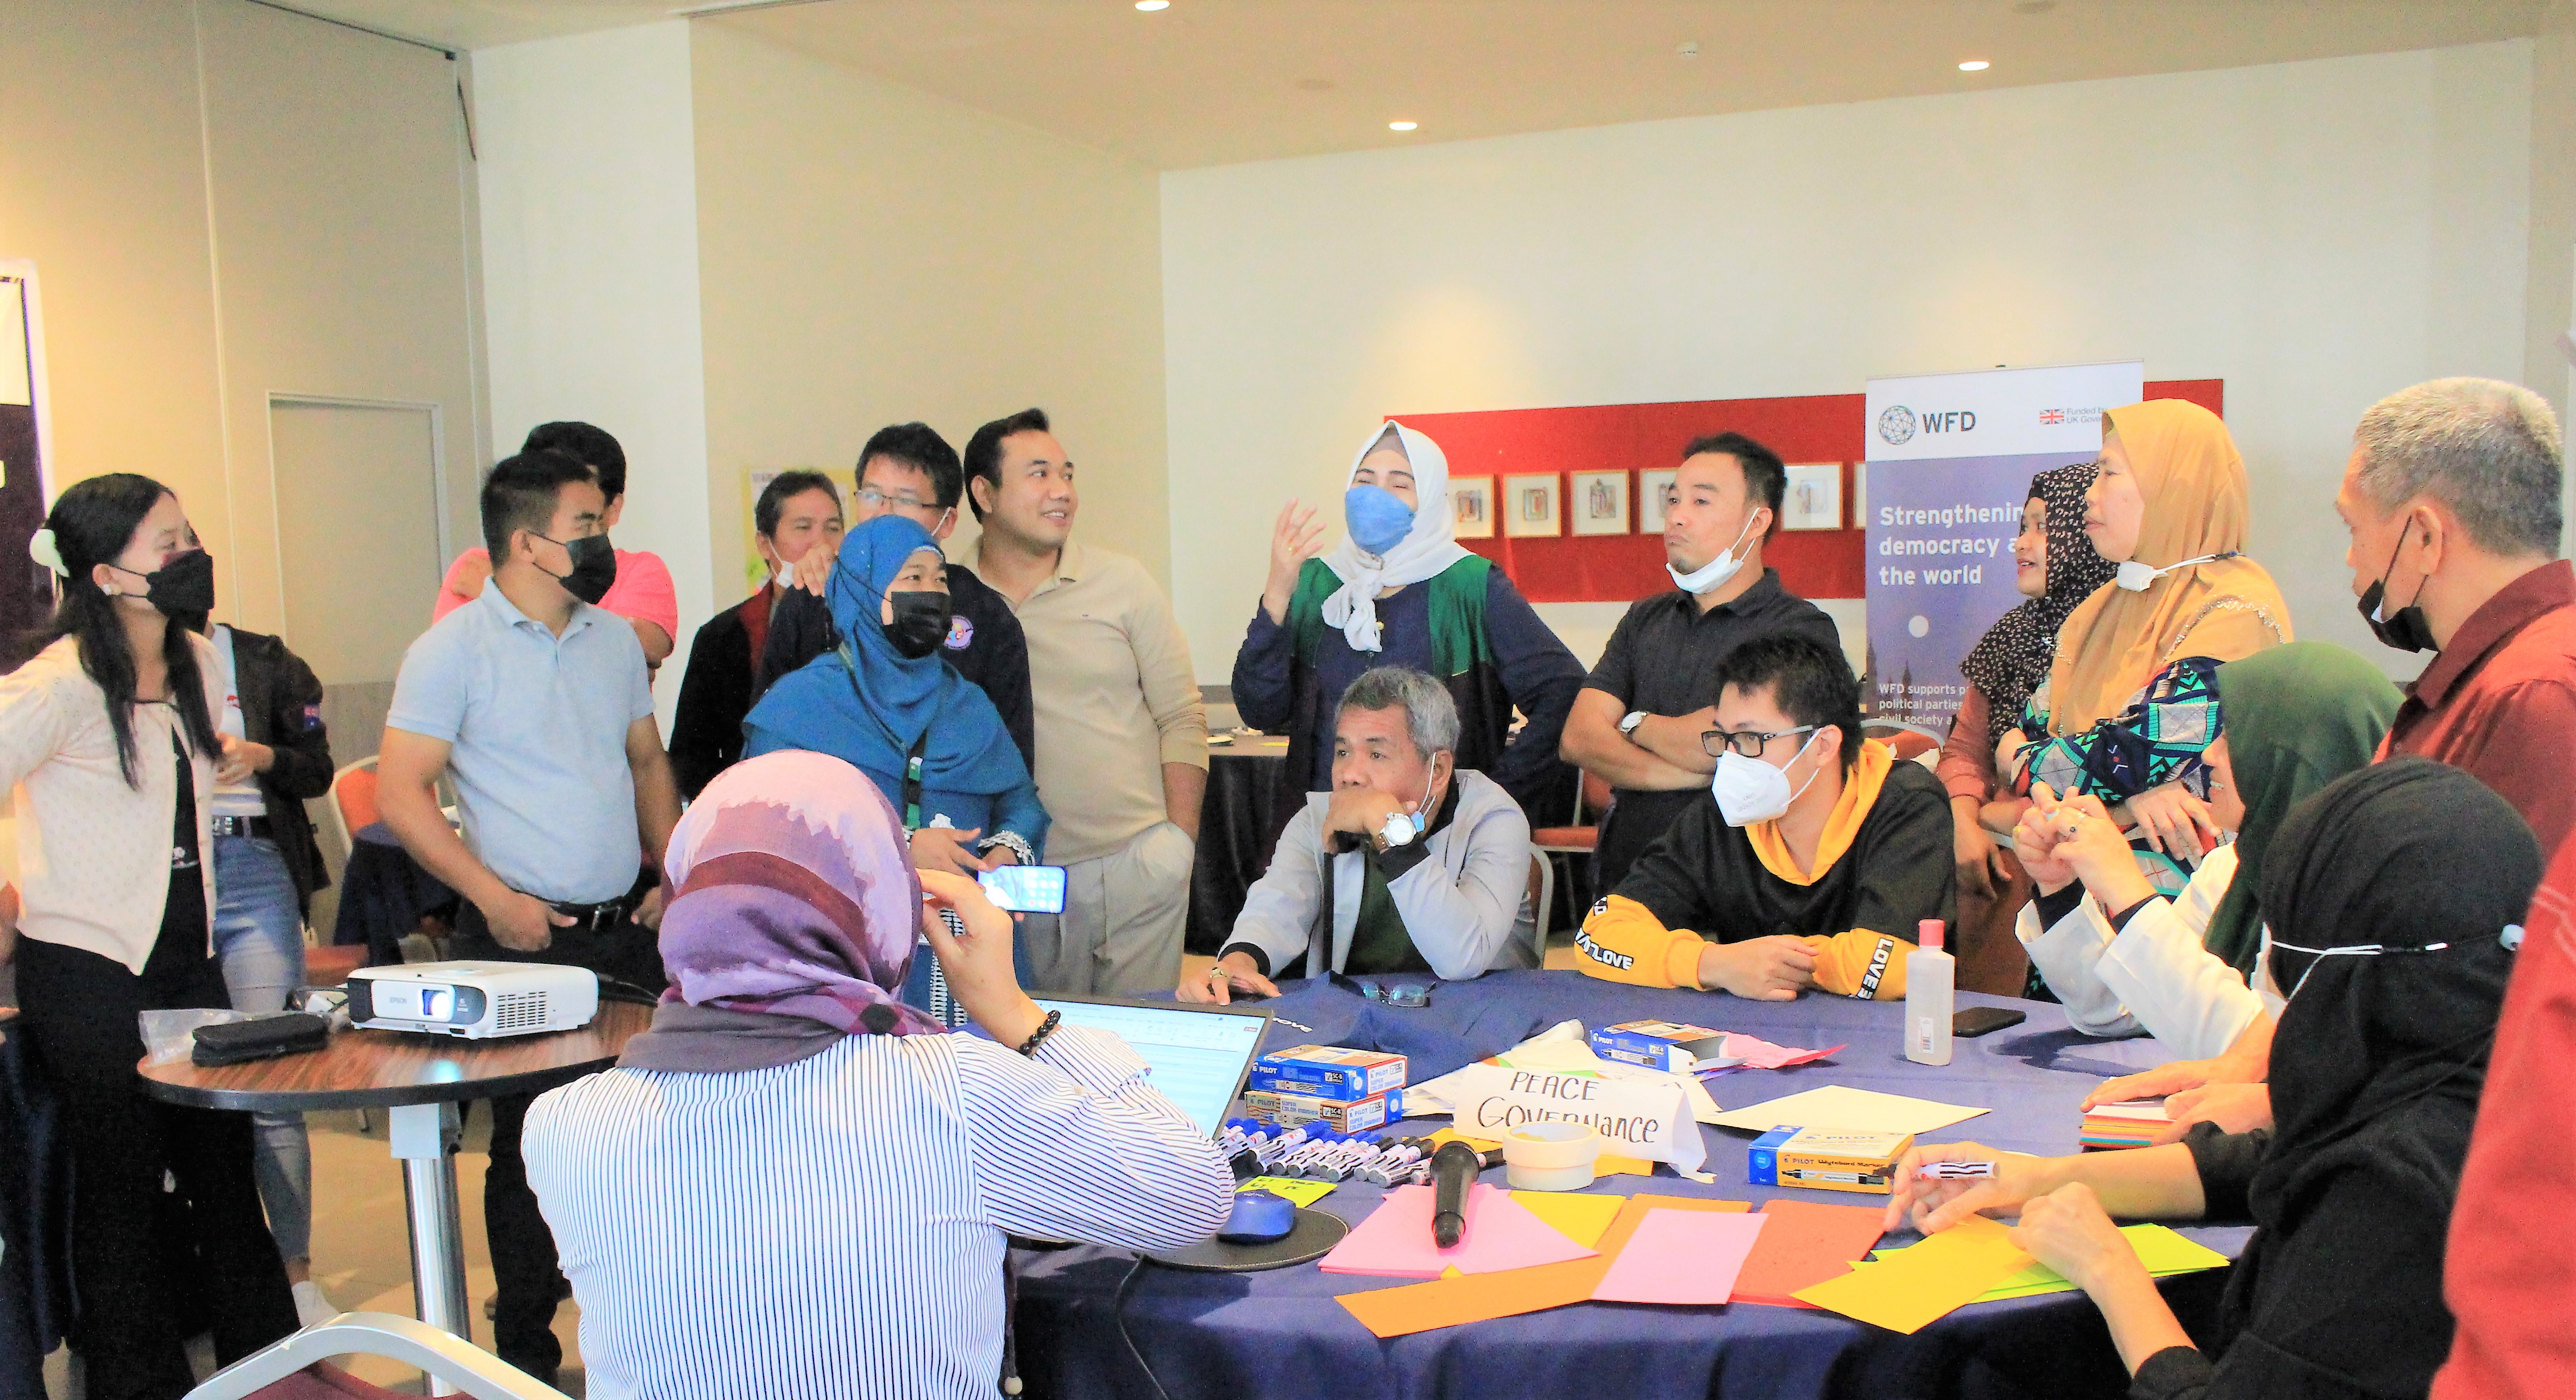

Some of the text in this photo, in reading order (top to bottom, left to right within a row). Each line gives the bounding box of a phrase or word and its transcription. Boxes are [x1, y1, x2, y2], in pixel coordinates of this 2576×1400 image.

[1923, 411, 1976, 434] WFD
[1880, 502, 2024, 529] Strengthenin
[1879, 536, 2019, 558] democracy a
[1879, 564, 1982, 586] the world
[1879, 683, 1905, 695] WFD
[1908, 684, 1955, 696] supports
[1879, 699, 1923, 711] political
[1904, 713, 1944, 727] society
[1598, 1036, 1613, 1044] PILOT
[1259, 1066, 1277, 1074] PILOT
[1510, 1071, 1599, 1100] PEACE
[1355, 1108, 1368, 1116] PILOT
